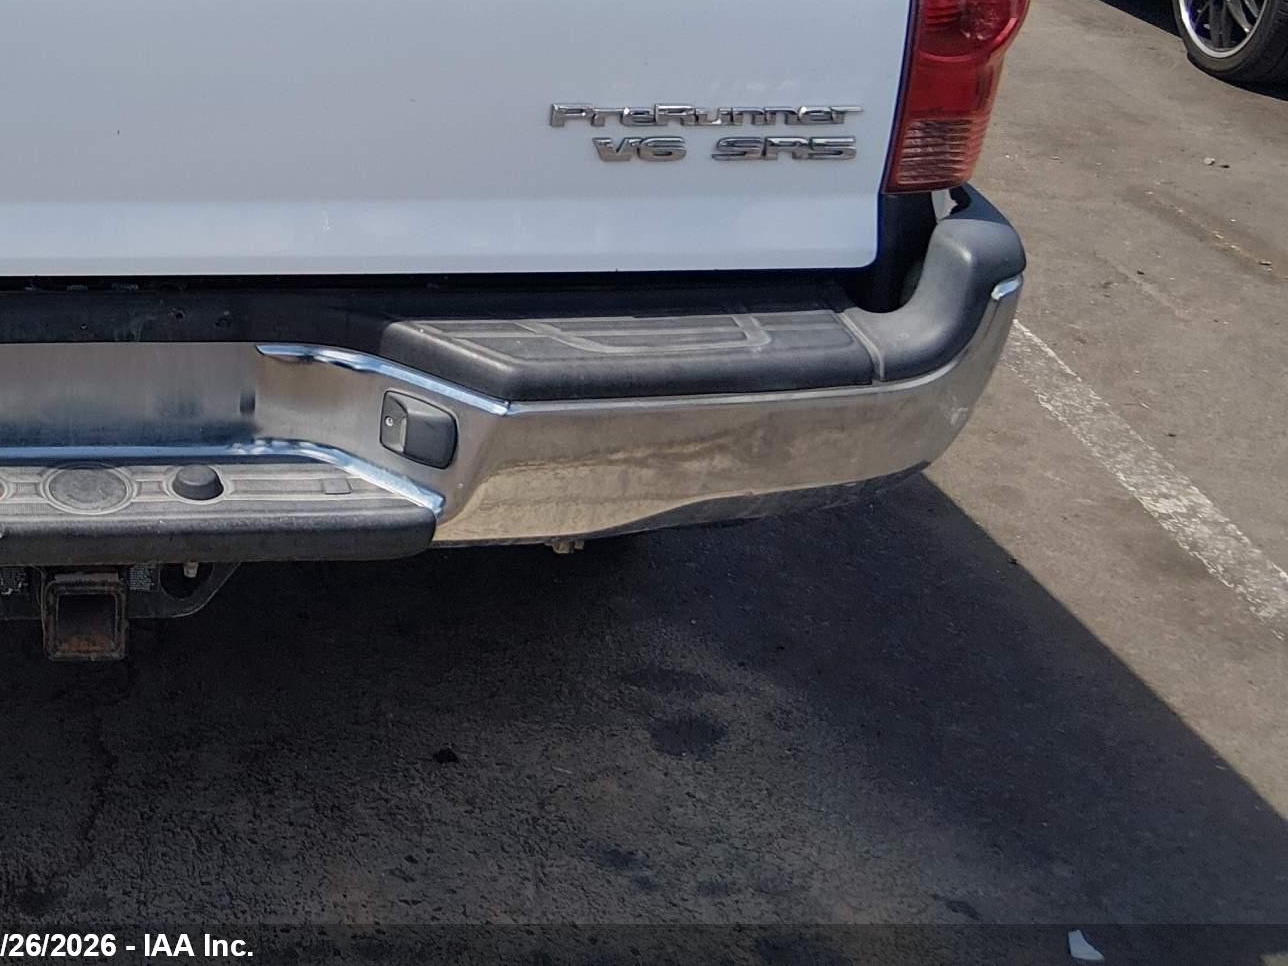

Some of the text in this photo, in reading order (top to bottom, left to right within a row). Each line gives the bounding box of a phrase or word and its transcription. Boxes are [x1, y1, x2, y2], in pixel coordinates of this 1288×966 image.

[549, 103, 863, 127] PreRunner
[591, 136, 857, 162] V6 SR5
